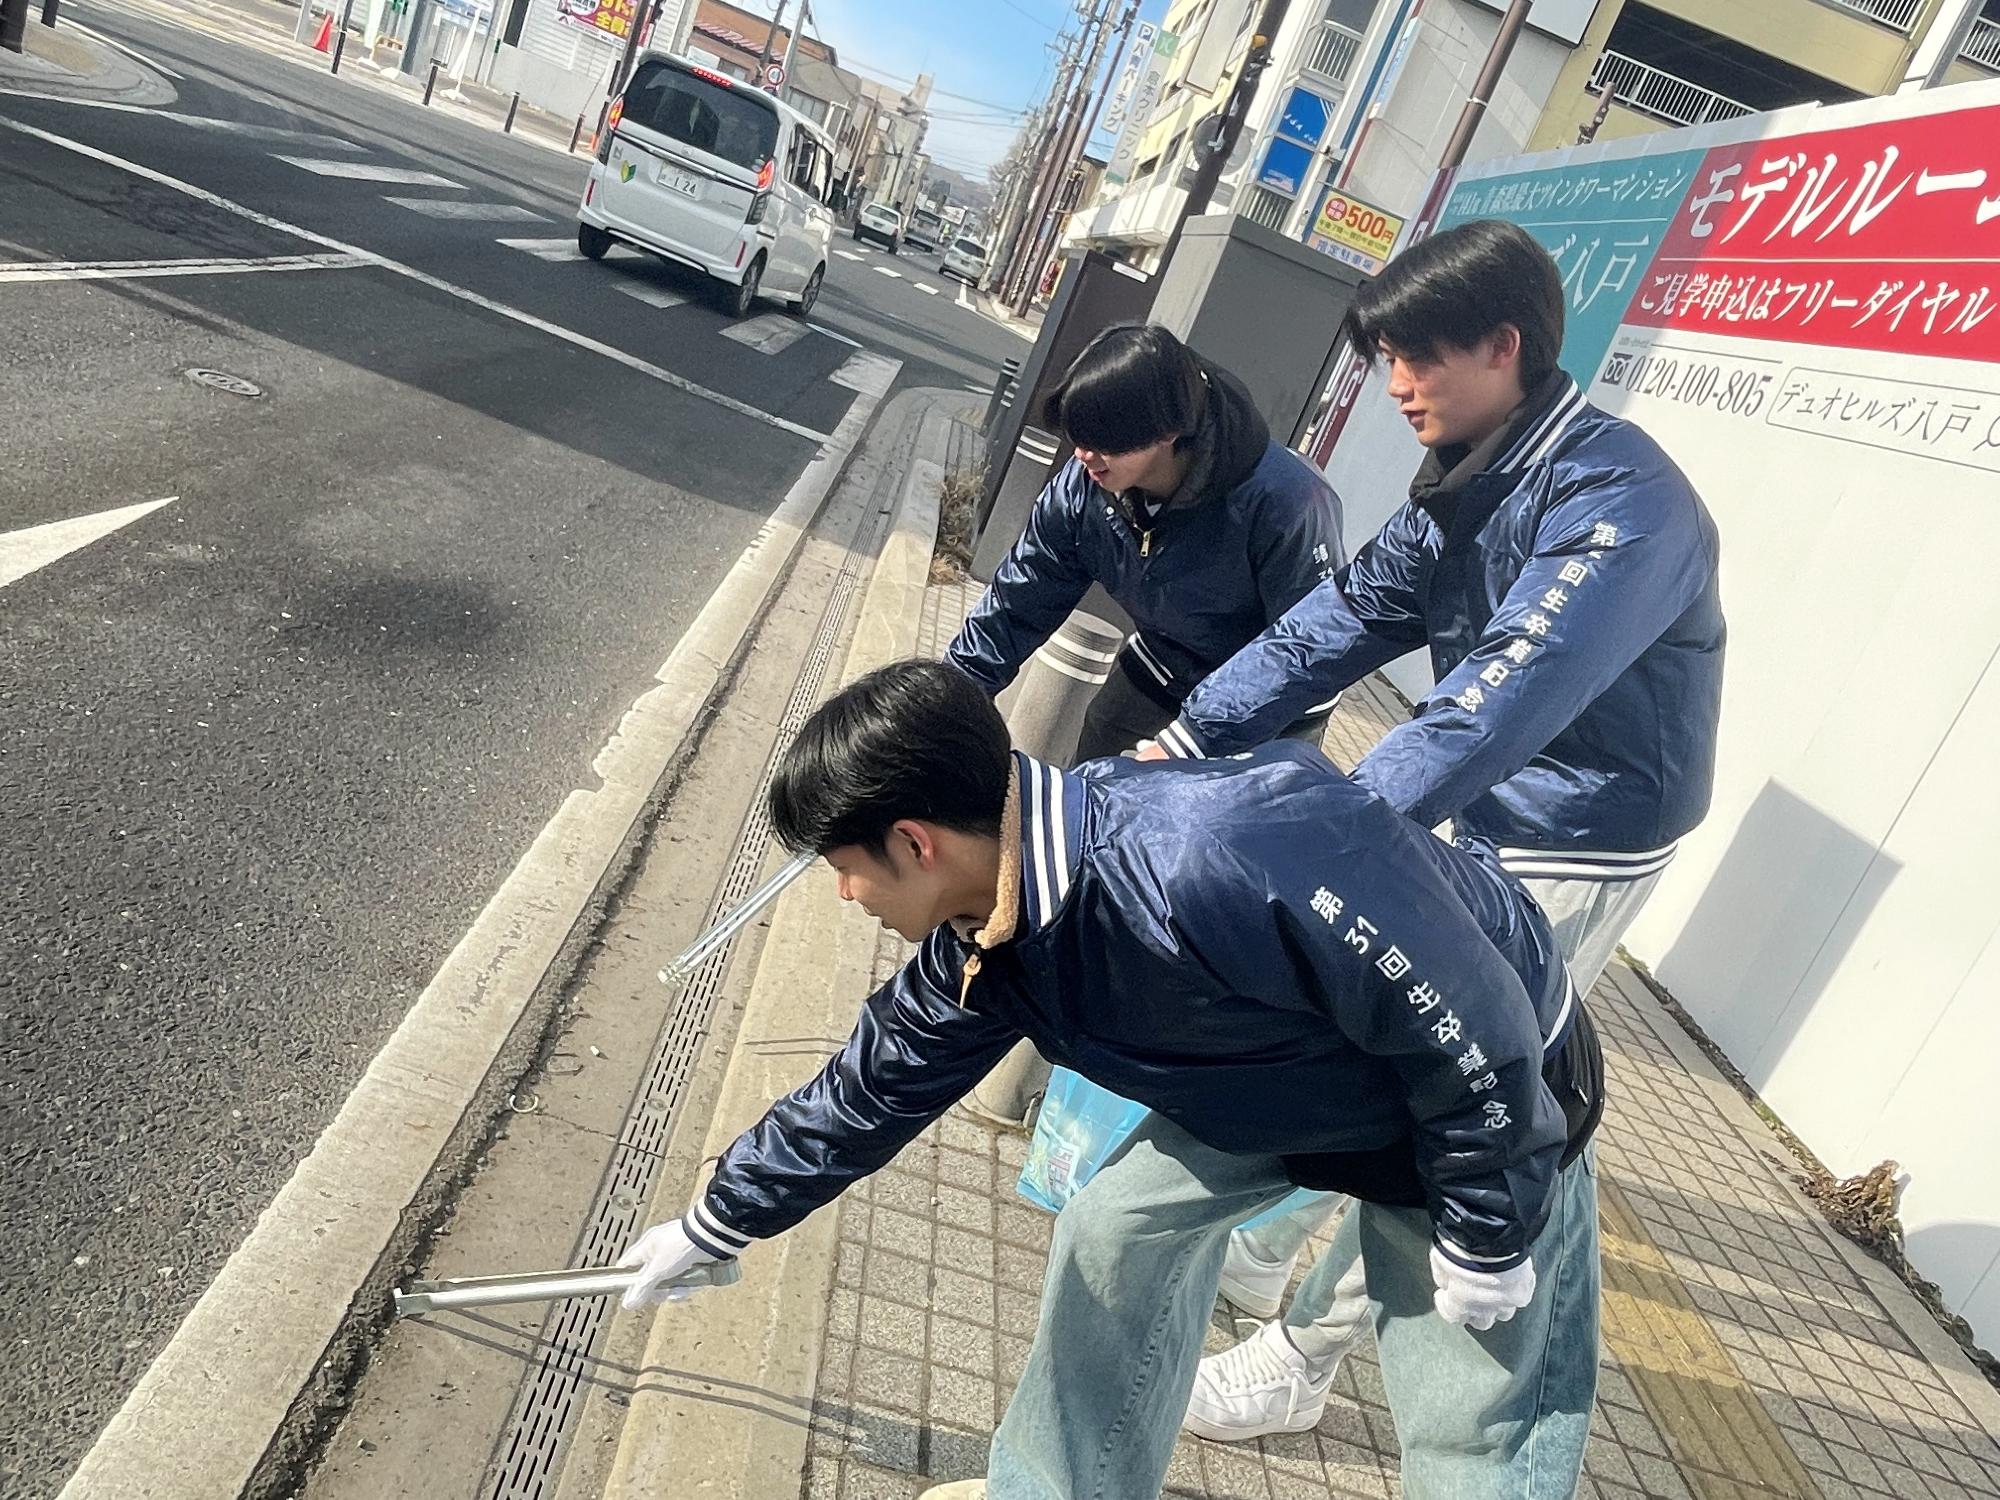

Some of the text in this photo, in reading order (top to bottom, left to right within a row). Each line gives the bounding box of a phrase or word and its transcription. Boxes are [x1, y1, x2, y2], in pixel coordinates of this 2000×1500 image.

[1689, 145, 2000, 244] モデルルー
[1641, 272, 1998, 335] ご見学申込はフリーダイヤル
[1624, 356, 1774, 417] 0120-100-805
[1777, 382, 1981, 445] デュオヒルズ八戸
